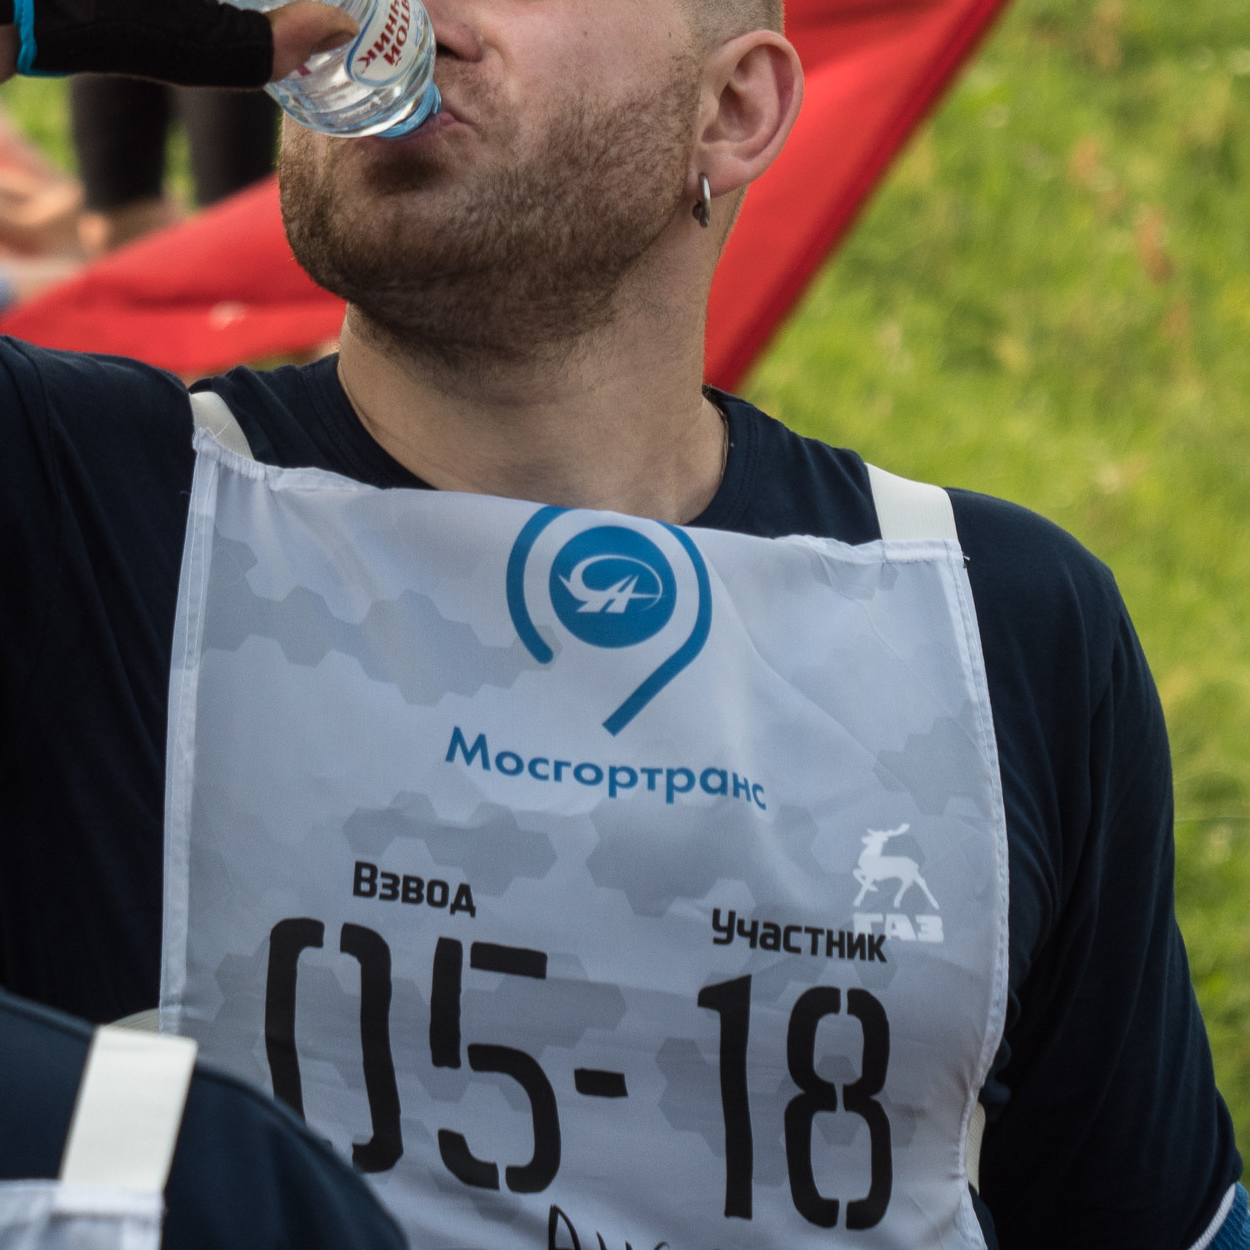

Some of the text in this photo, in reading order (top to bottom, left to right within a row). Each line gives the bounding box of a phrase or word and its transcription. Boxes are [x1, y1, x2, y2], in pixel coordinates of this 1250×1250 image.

[445, 725, 767, 811] Мосгортранс
[352, 861, 476, 917] Взвод
[712, 908, 888, 963] Участник
[852, 912, 945, 944] ГАЗ
